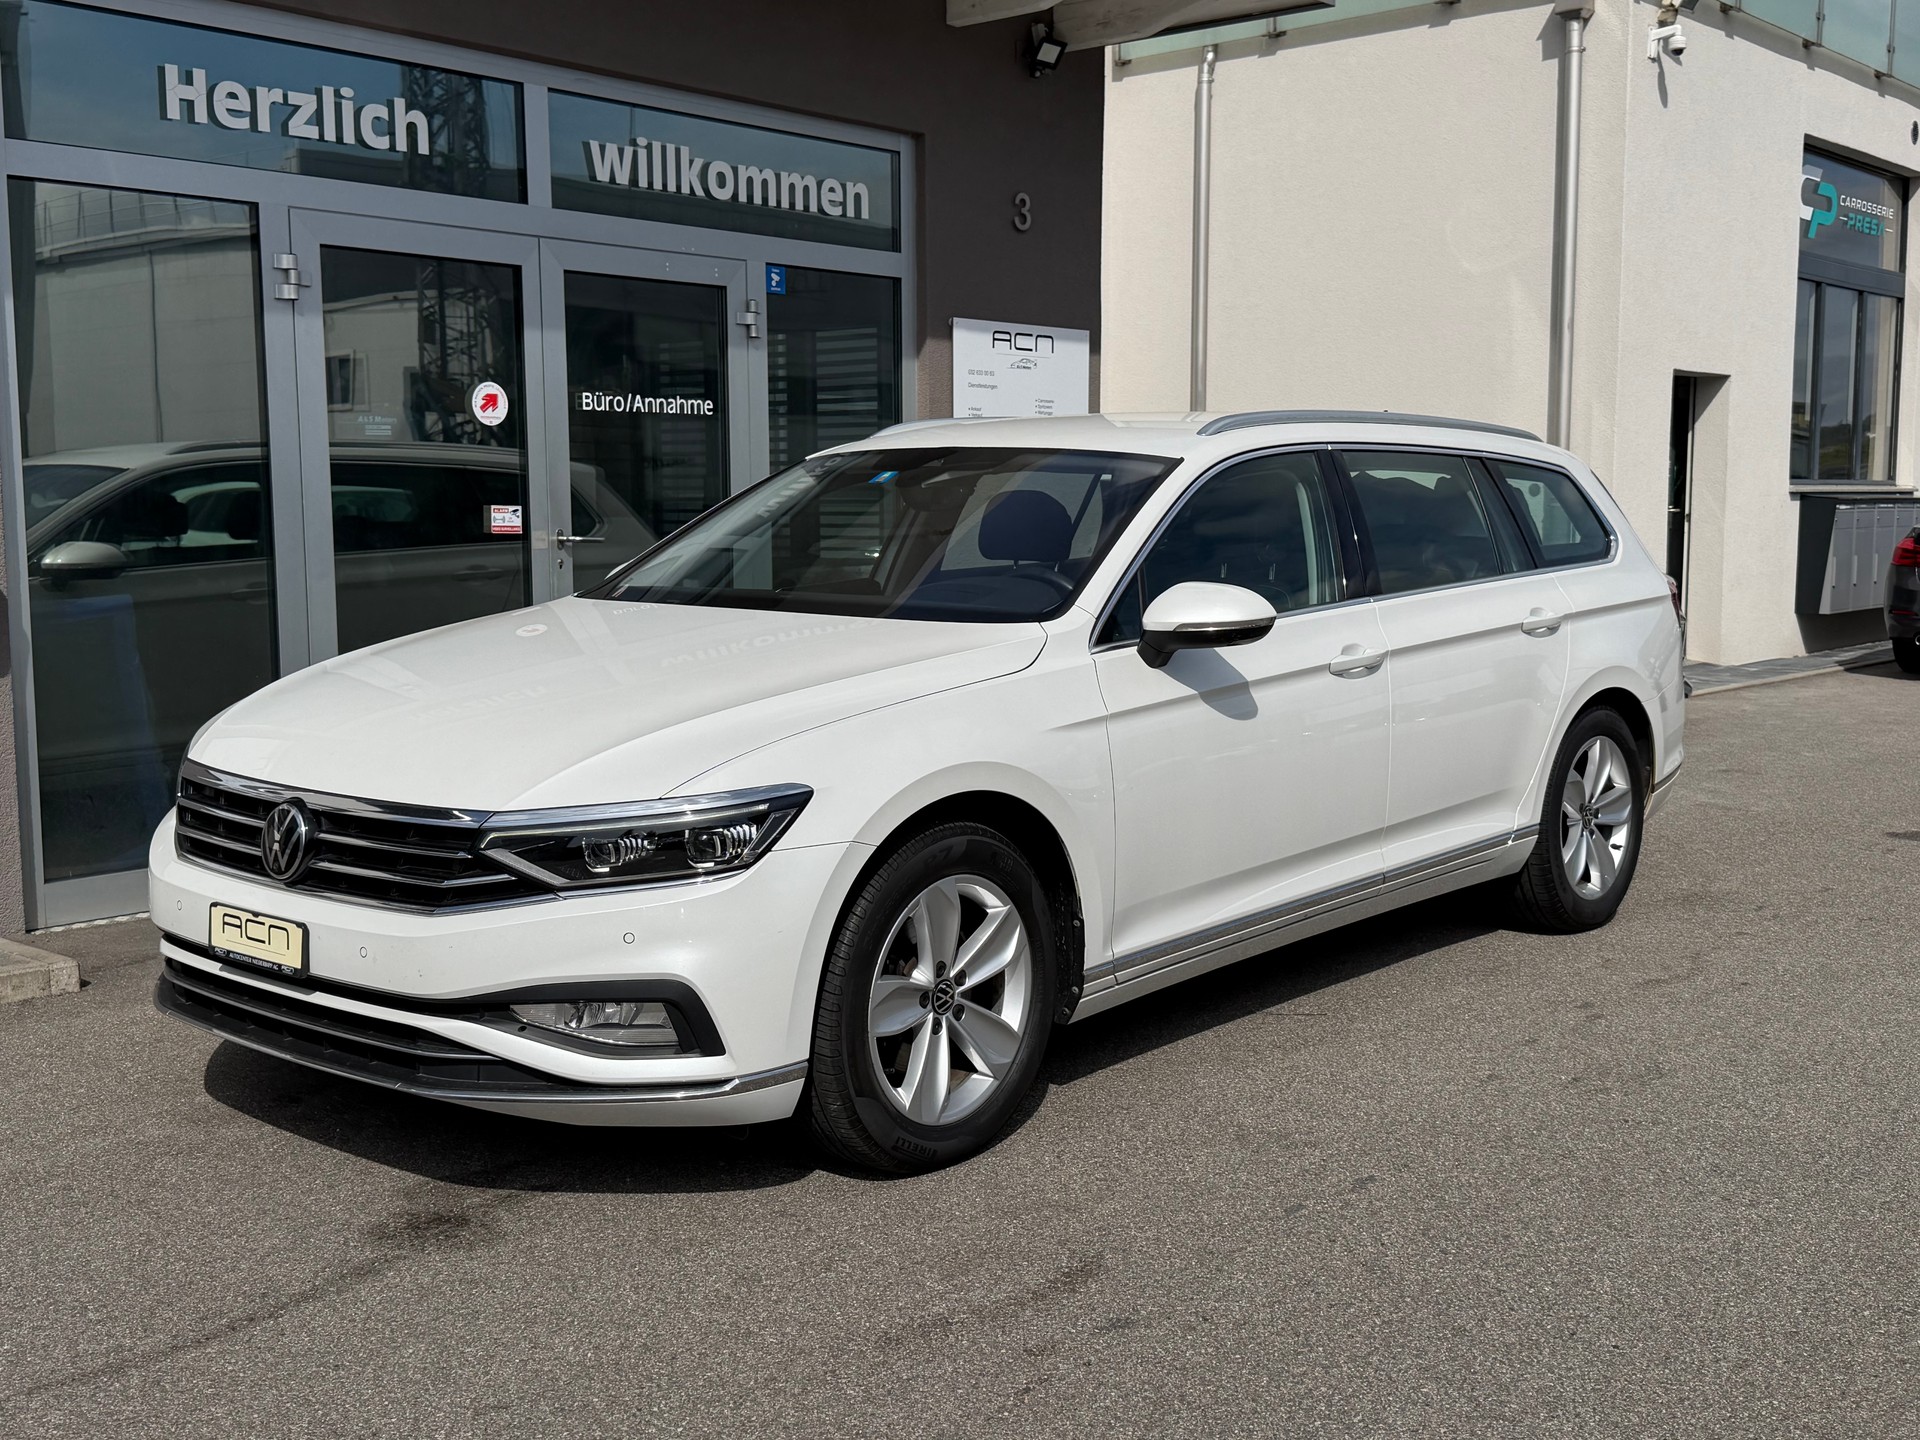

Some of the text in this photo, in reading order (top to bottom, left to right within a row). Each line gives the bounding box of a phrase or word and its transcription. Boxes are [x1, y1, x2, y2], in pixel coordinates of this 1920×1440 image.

[164, 63, 430, 155] Herzlich
[589, 136, 869, 219] willkommen
[1014, 192, 1032, 231] 3
[1839, 194, 1895, 219] CARROSSERIE
[992, 330, 1054, 354] ACN
[581, 391, 714, 416] Büro/Annahme
[222, 912, 290, 951] ACN
